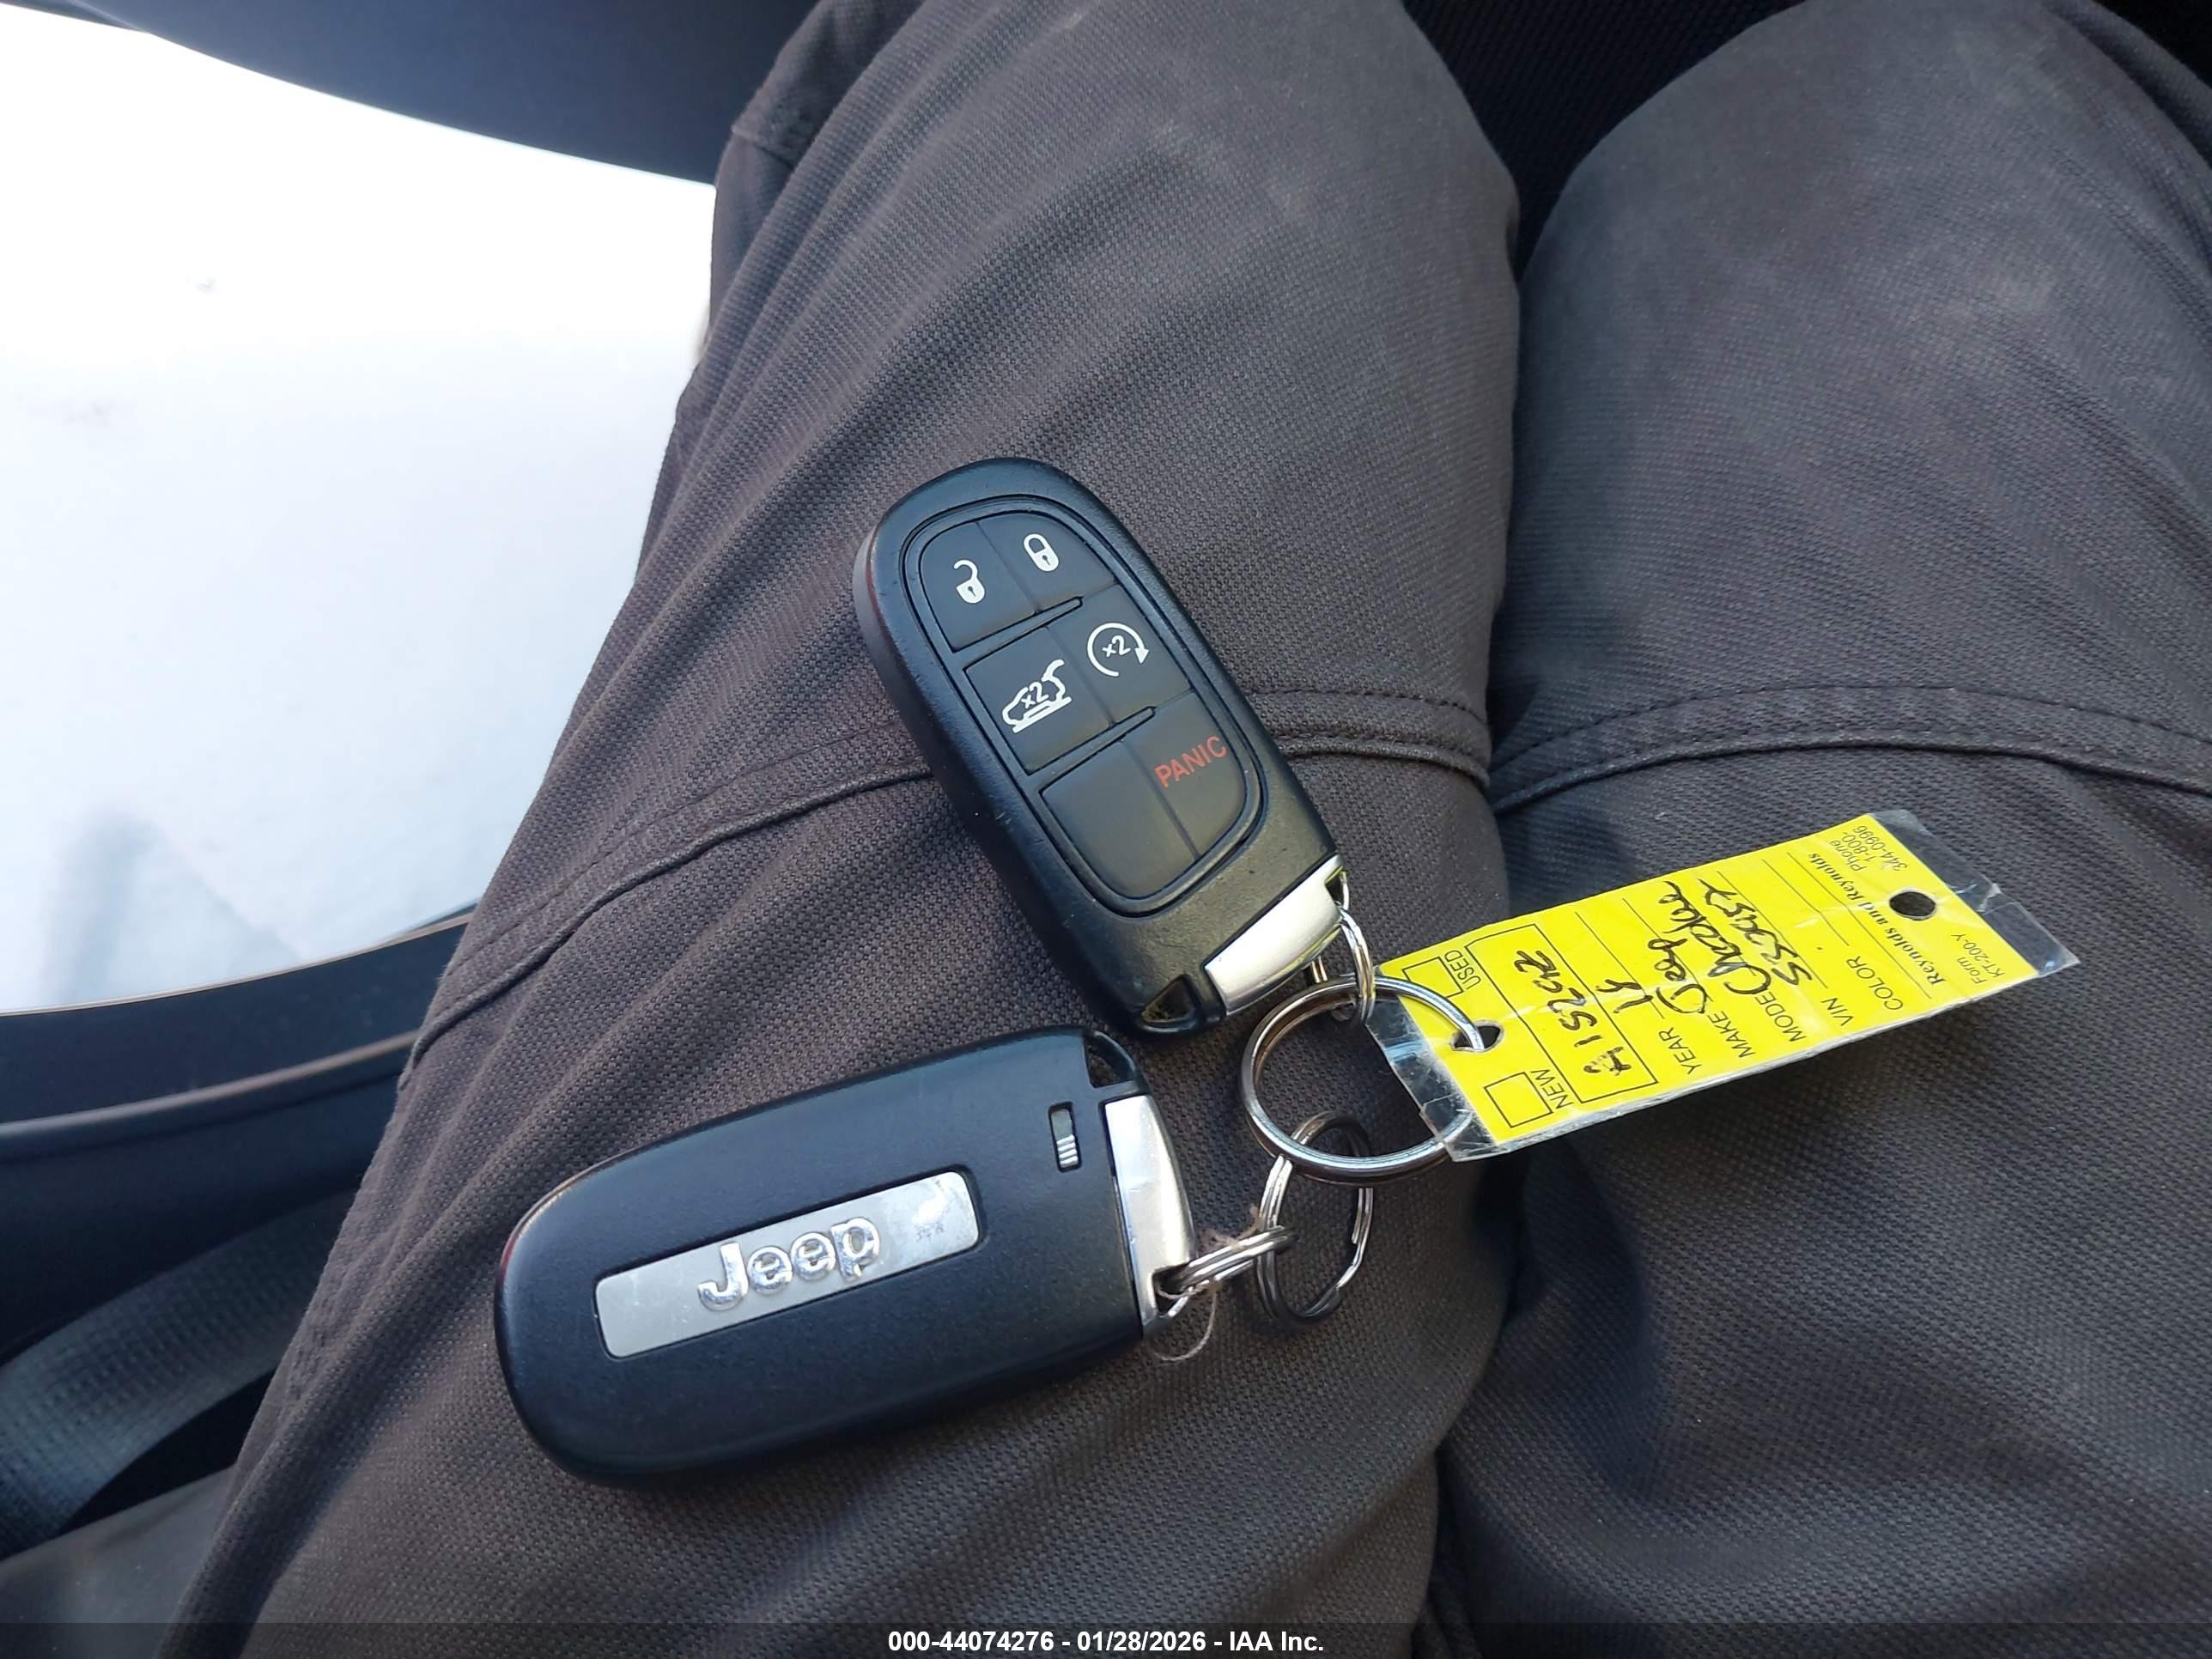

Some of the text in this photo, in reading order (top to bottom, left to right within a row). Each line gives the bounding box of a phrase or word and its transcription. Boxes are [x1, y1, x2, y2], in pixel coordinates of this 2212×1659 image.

[1155, 736, 1226, 787] PANIC
[1830, 841, 1867, 871] Phone
[1854, 826, 1907, 871] 344-0996
[1809, 854, 1946, 985] Reynolds and Reynolds
[1444, 951, 1481, 988] USED
[1648, 937, 1710, 1014] Jeep
[1951, 934, 2004, 977] KT-200-Y
[1958, 957, 1987, 983] Form
[1846, 956, 1903, 1010] COLOR
[1707, 1011, 1755, 1058] MAKE
[1820, 998, 1854, 1026] VIN
[1659, 1027, 1702, 1074] YEAR
[1530, 1069, 1573, 1109] NEW
[697, 1217, 880, 1312] Jeep
